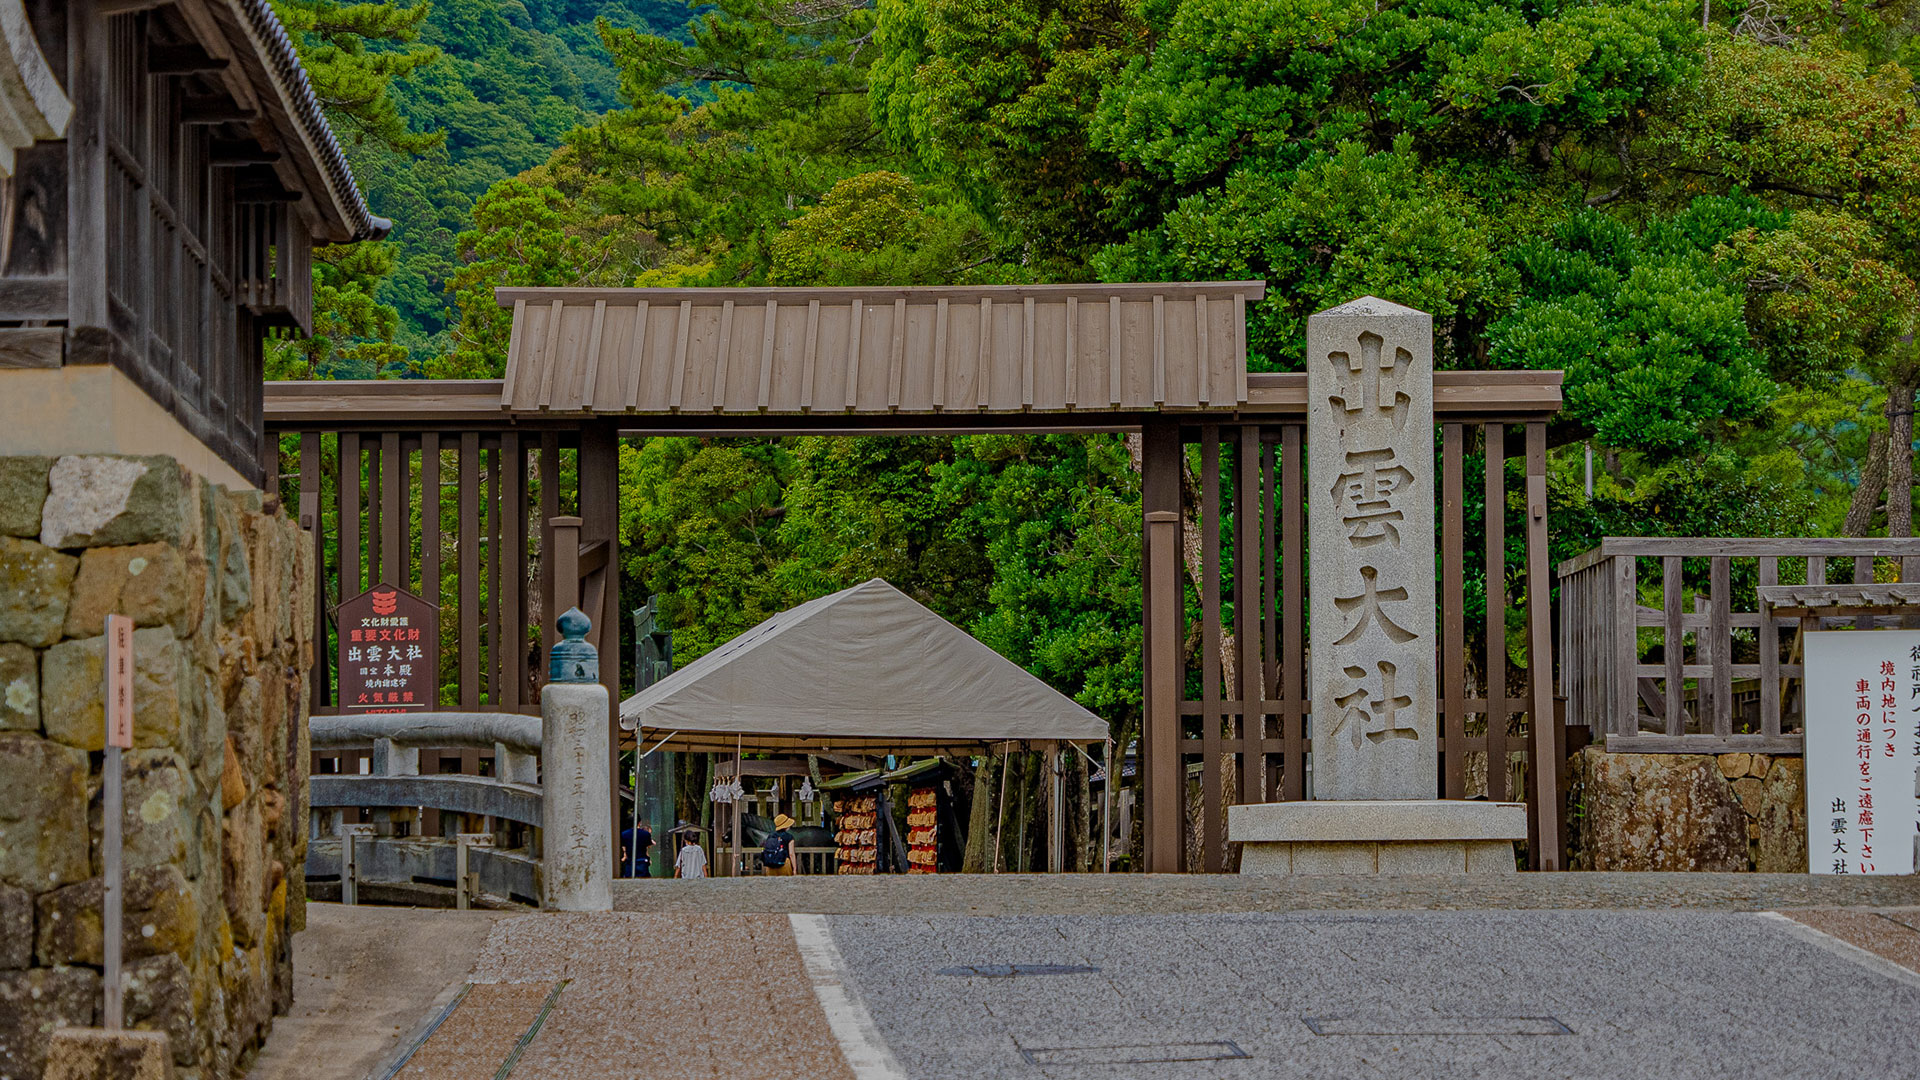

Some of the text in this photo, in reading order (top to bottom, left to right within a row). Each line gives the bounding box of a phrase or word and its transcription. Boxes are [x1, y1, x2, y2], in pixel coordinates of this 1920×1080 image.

[1326, 329, 1420, 751] 出雲大社
[348, 644, 423, 662] 出雲大社
[351, 628, 420, 642] 重要文化財
[383, 663, 412, 676] 本殿
[358, 691, 414, 703] 火気厳禁
[1880, 660, 1897, 758] 境内地につき
[1855, 678, 1876, 874] 車両の通行をご遠慮下さい
[1831, 797, 1849, 875] 出雲大社
